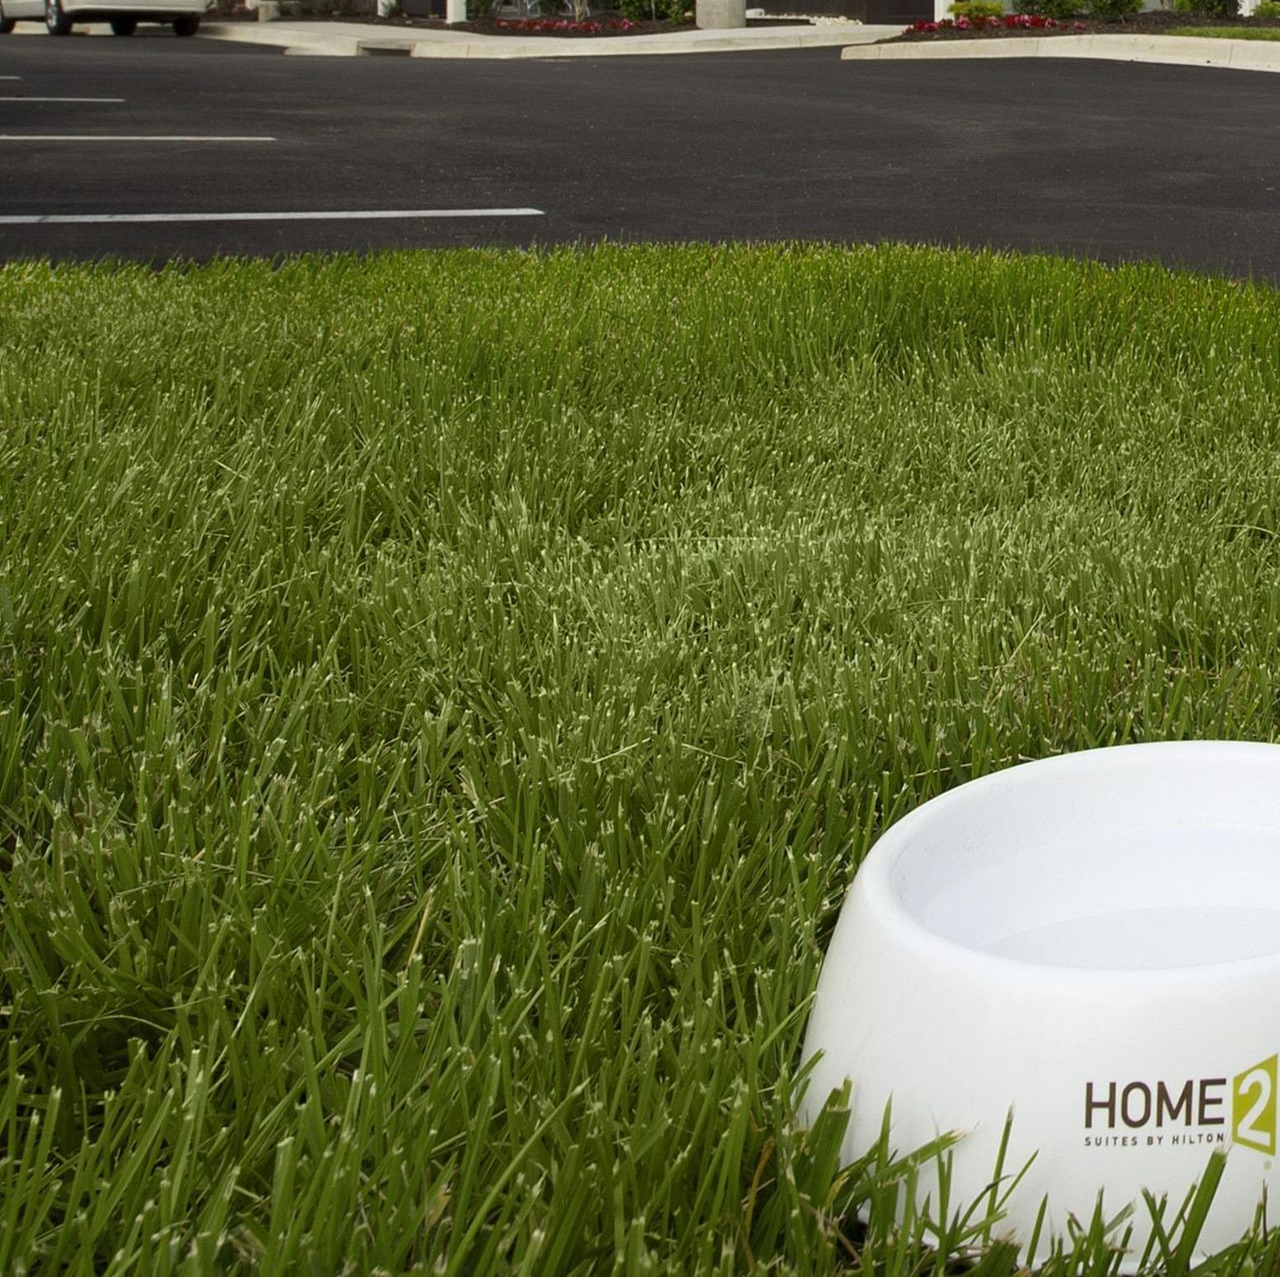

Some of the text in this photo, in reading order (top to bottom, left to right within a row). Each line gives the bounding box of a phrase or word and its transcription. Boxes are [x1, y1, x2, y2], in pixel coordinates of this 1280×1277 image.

[1084, 1132, 1225, 1147] SUITES BY HILTON
